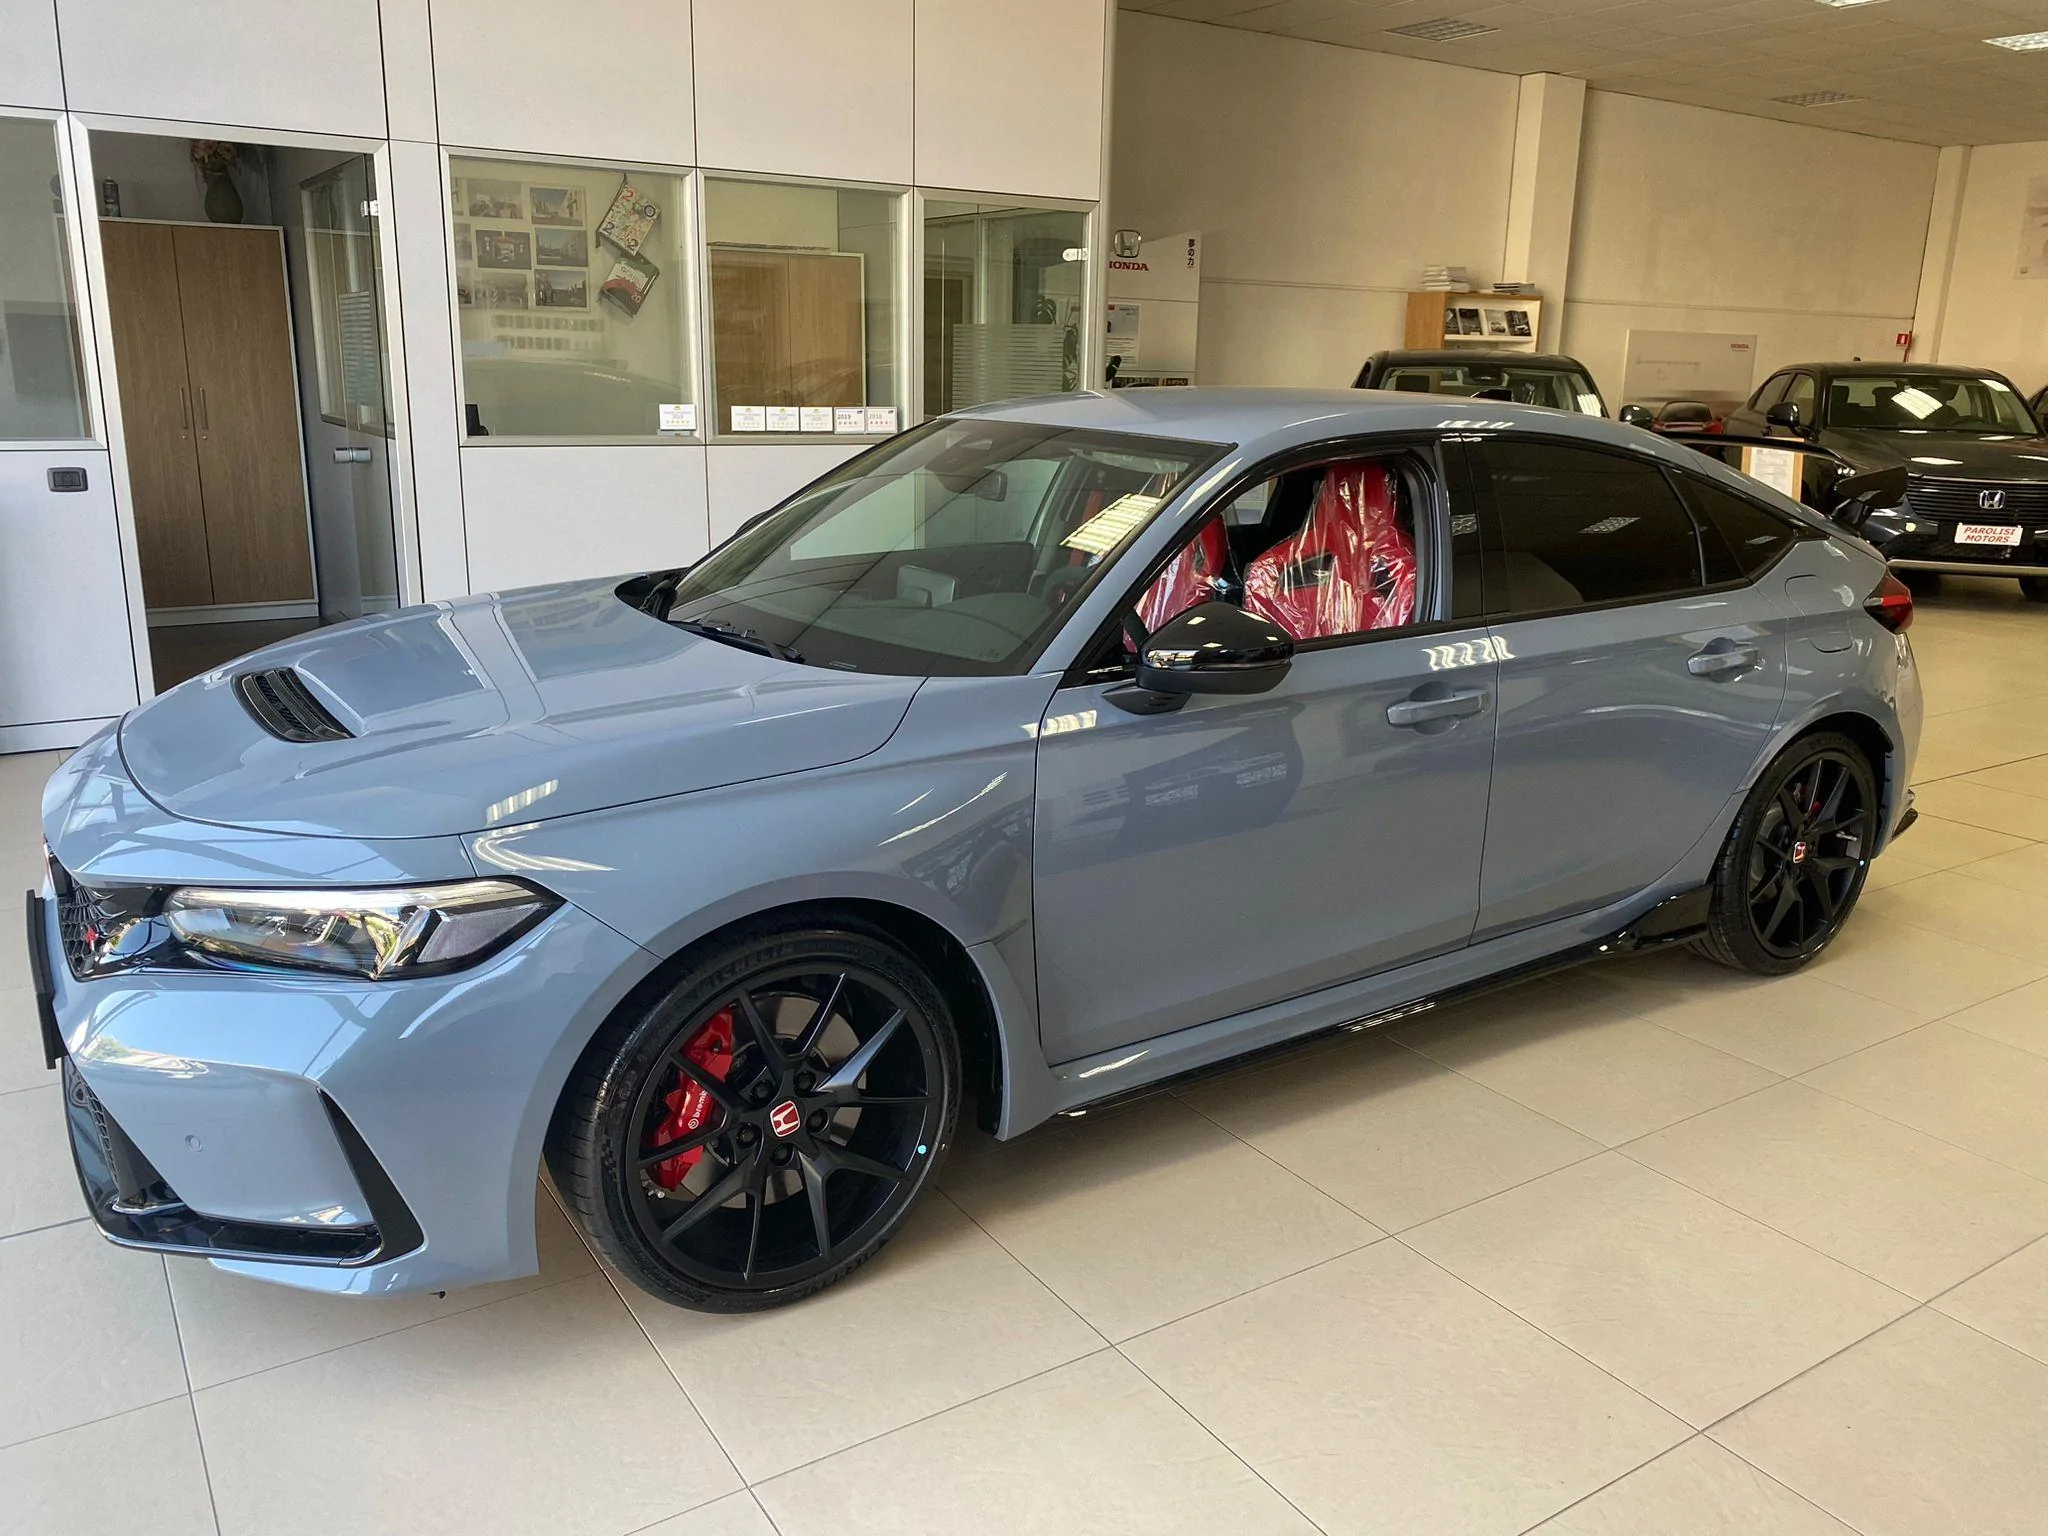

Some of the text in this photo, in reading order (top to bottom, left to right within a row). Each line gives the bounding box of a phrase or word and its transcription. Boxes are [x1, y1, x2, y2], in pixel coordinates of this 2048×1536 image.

[1964, 526, 2017, 536] PAROLISI
[1964, 534, 2011, 544] MOTORS
[693, 1089, 707, 1118] bremb
